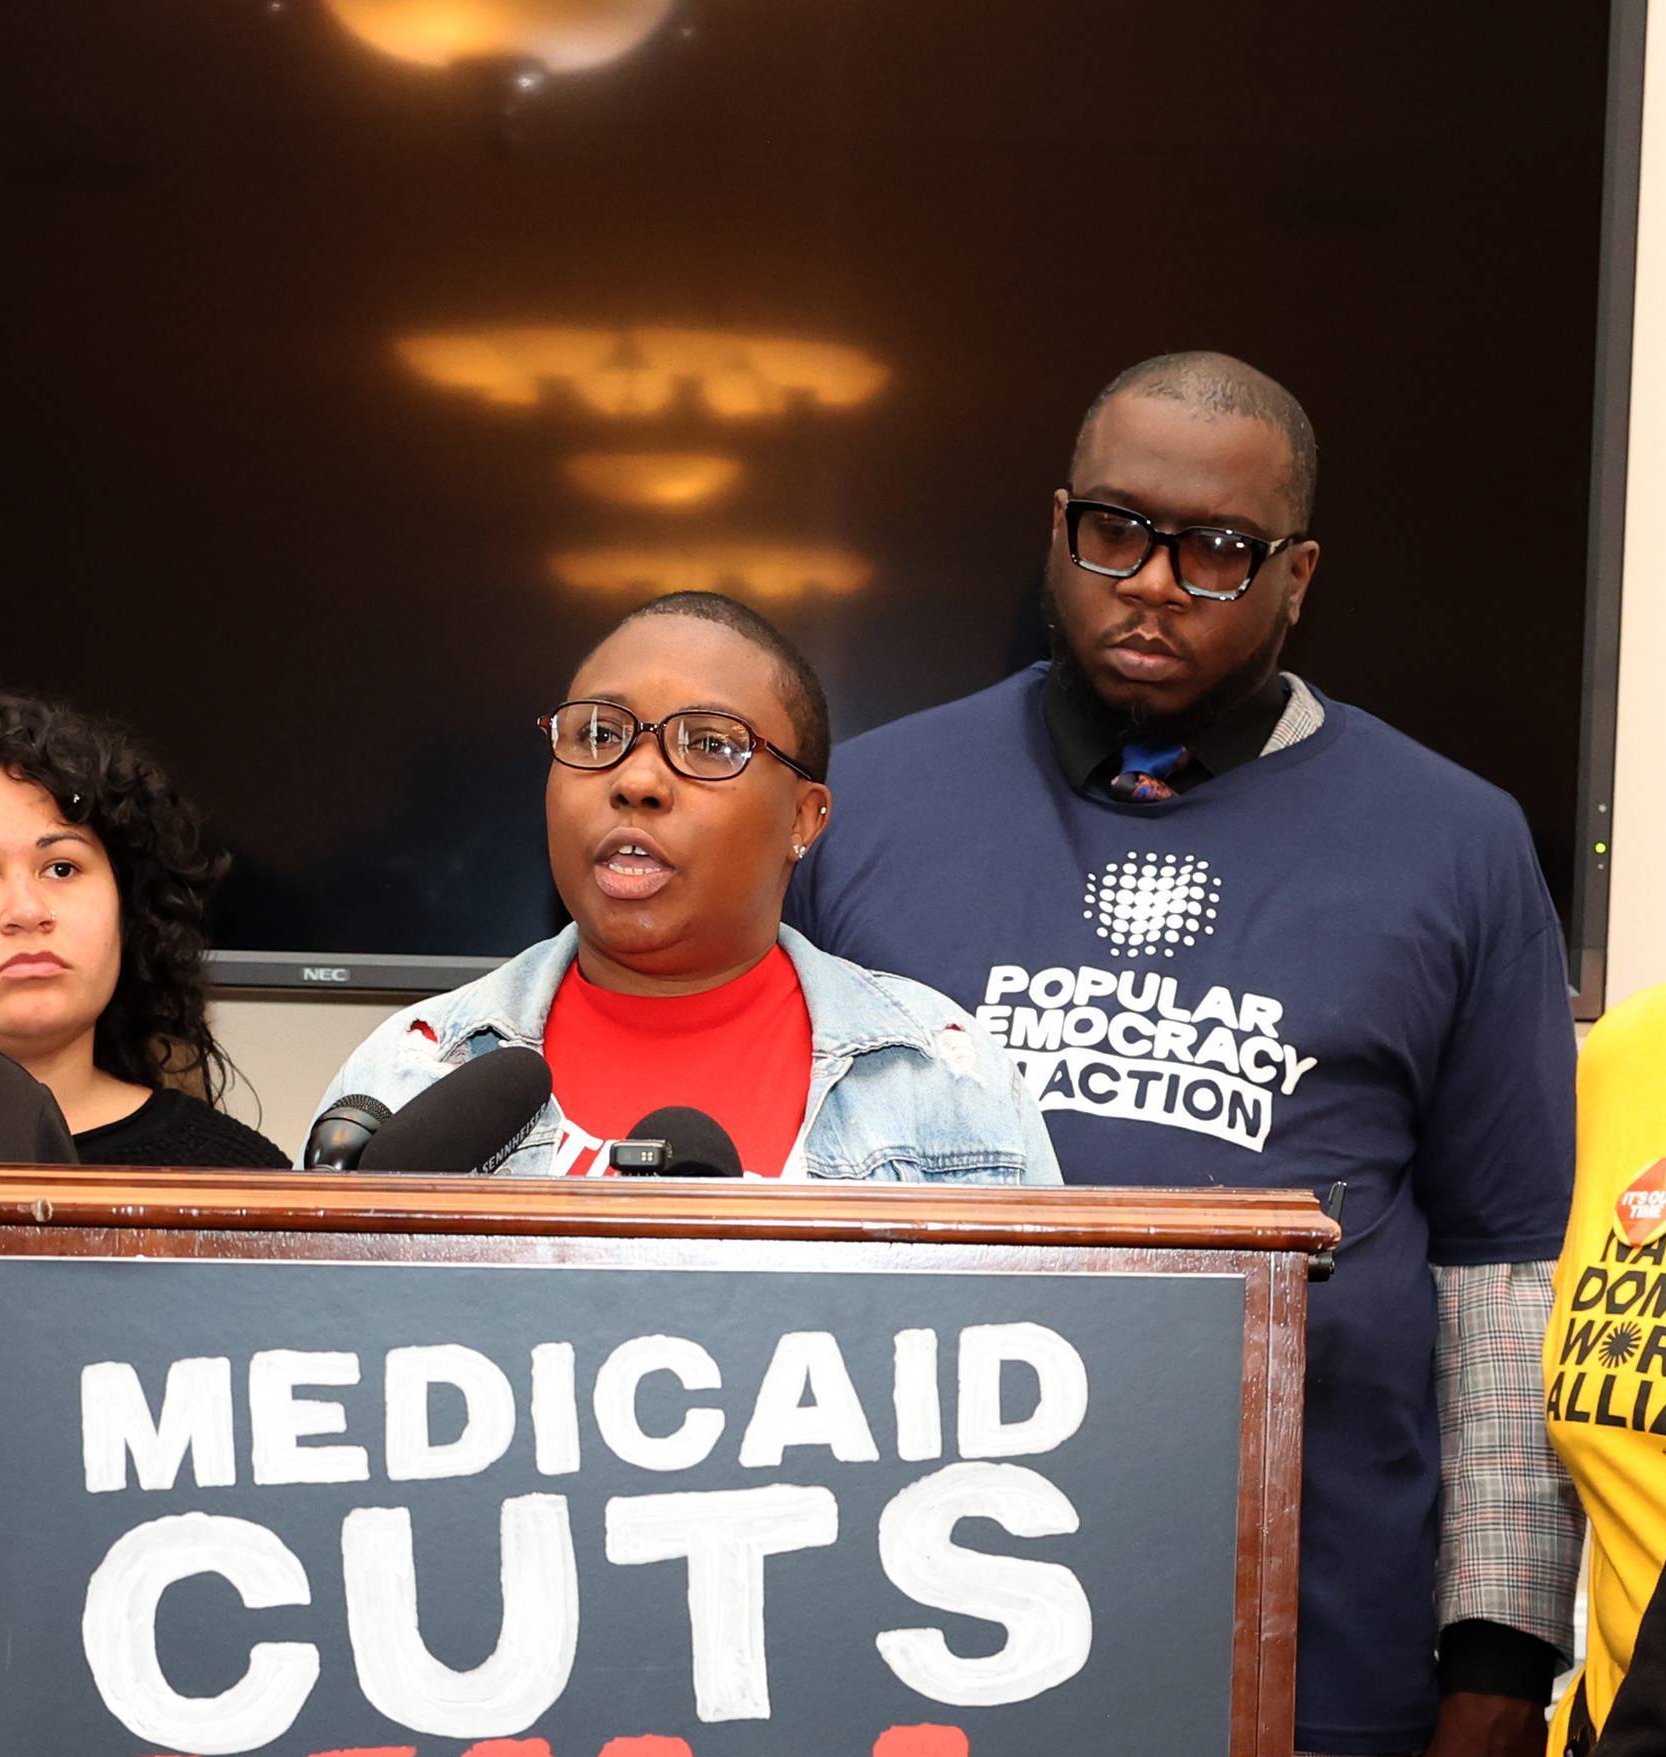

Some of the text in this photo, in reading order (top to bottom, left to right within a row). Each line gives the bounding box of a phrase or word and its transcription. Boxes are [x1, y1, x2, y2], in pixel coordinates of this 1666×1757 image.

[303, 967, 349, 982] NEC
[984, 965, 1283, 1038] POPULAR
[976, 1005, 1318, 1095] EMOCRACY
[1039, 1059, 1262, 1138] ACTION
[79, 1321, 1088, 1493] MEDICAID
[82, 1461, 1092, 1756] CUTS
